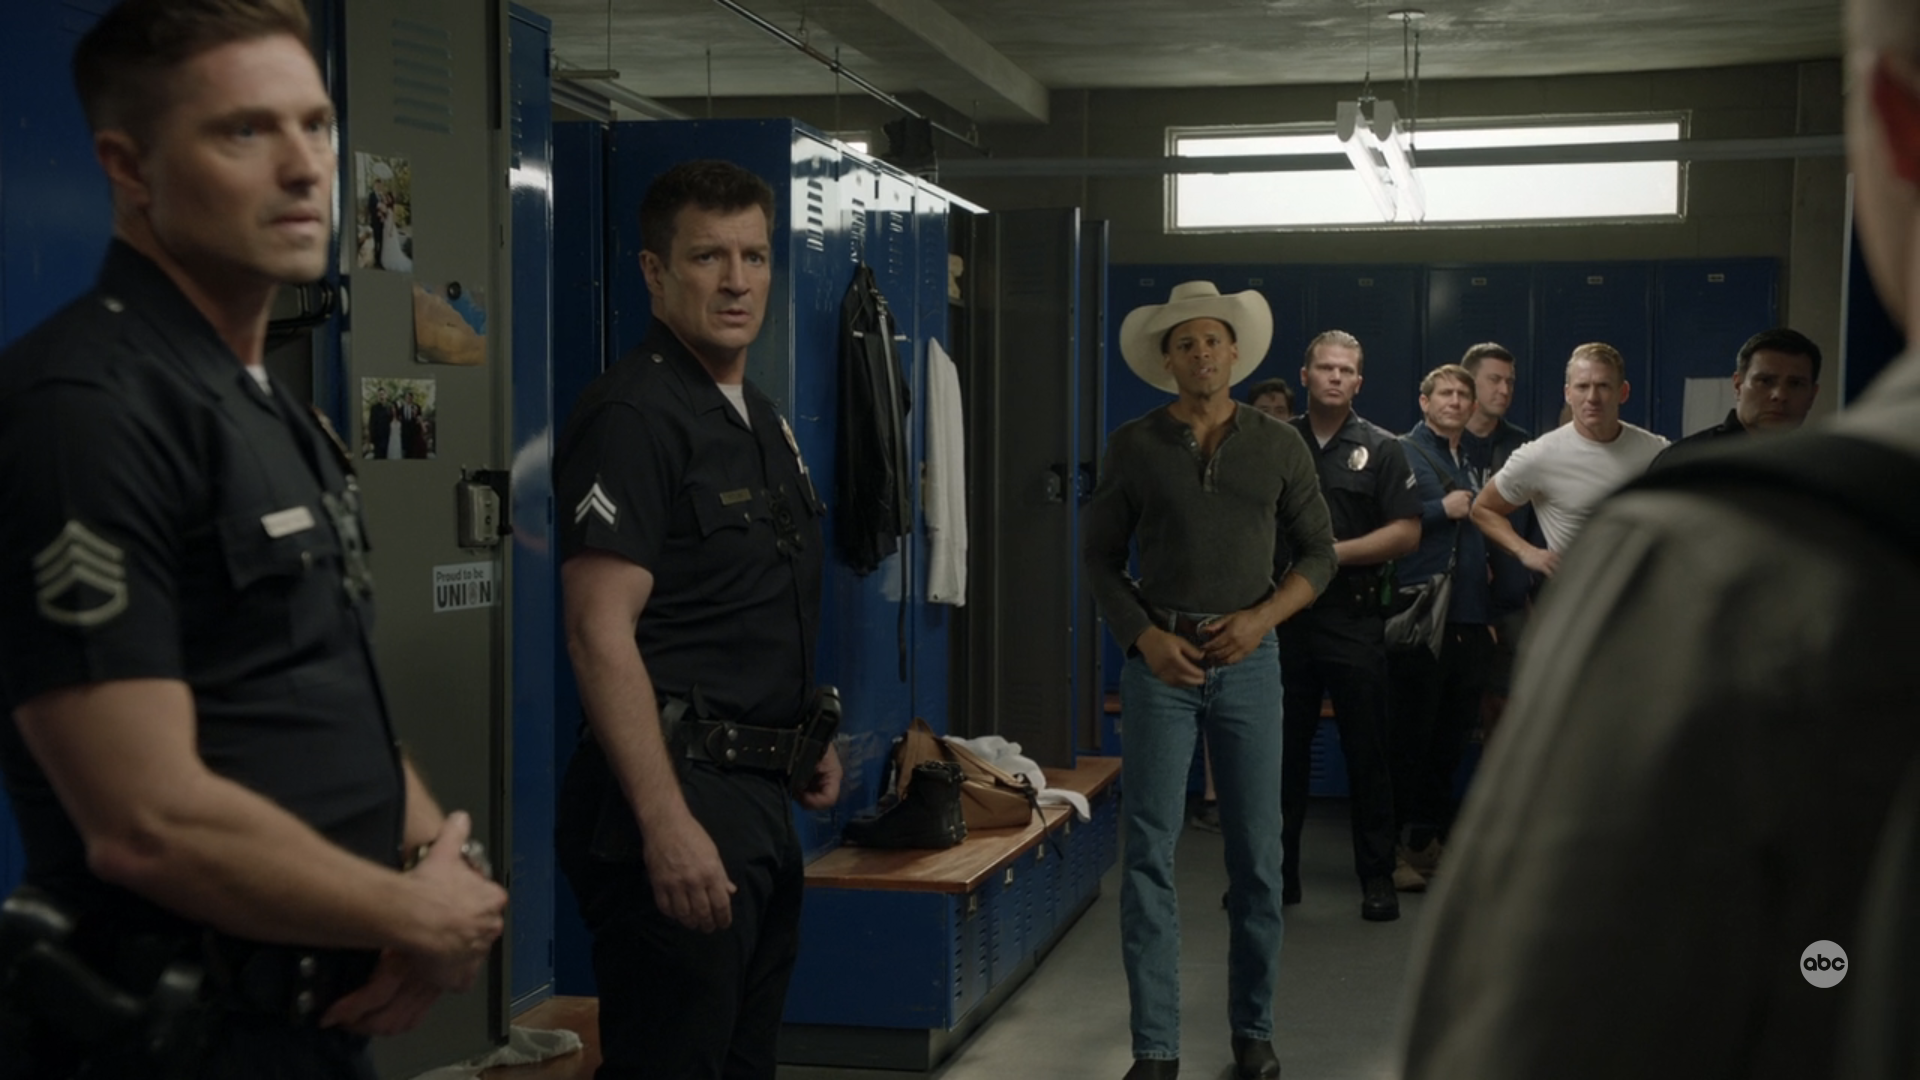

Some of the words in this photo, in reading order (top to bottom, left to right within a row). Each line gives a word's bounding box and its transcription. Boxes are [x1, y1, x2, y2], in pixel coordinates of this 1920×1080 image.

[437, 569, 461, 582] Proud
[463, 570, 472, 580] to
[474, 567, 484, 579] be
[437, 581, 491, 608] UNION
